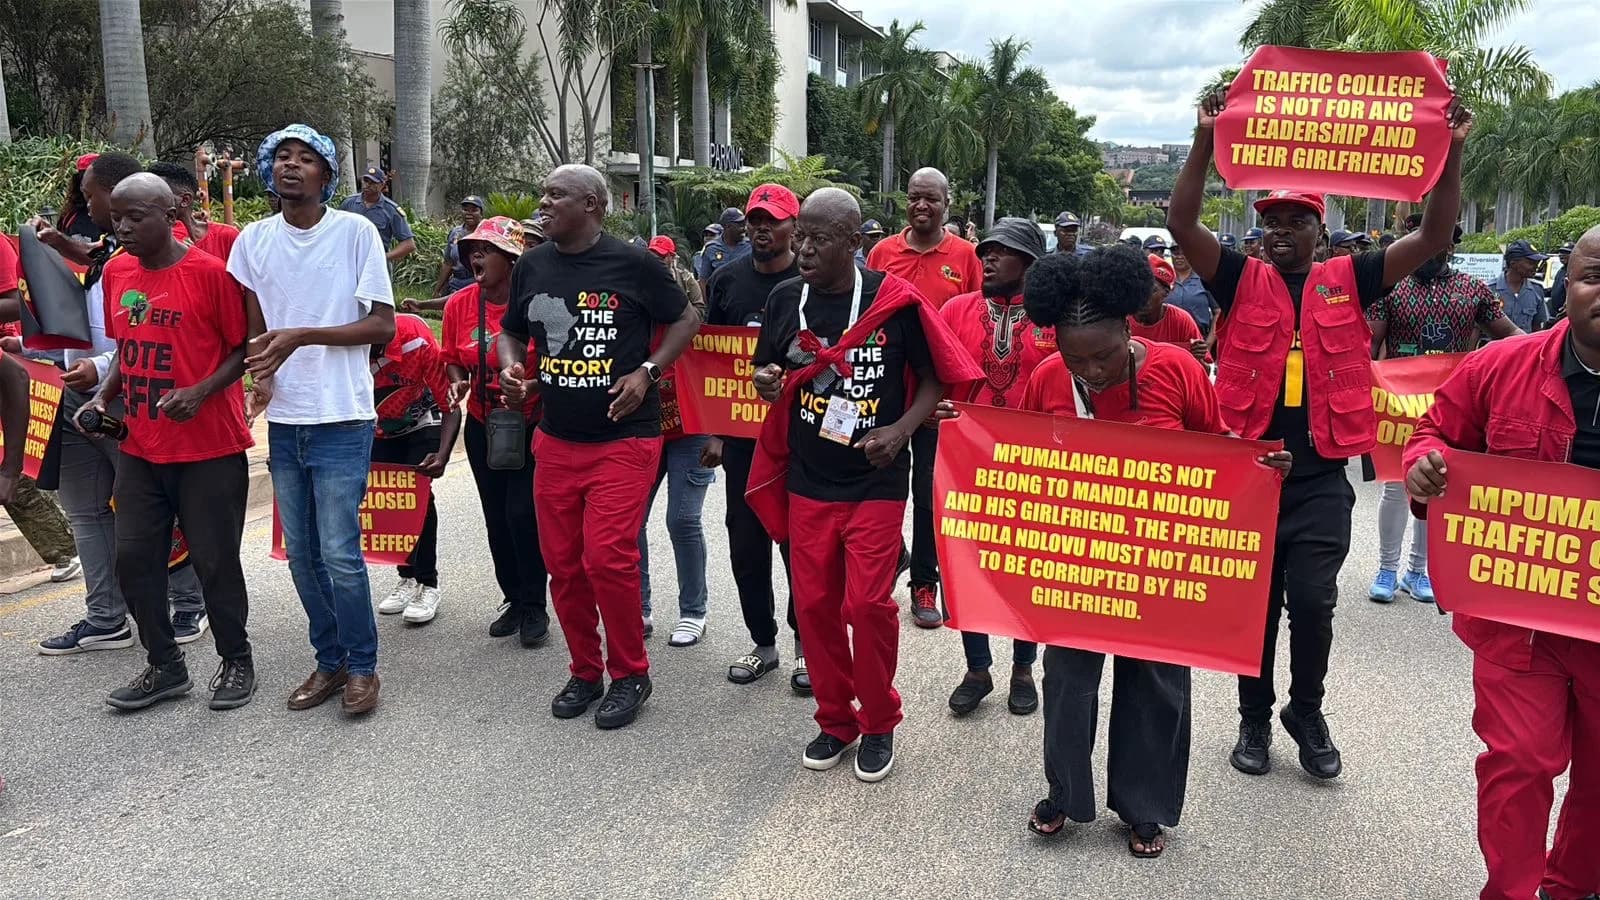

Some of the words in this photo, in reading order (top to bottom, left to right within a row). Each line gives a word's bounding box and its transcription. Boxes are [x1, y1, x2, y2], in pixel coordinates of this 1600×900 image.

[1252, 69, 1333, 94] TRAFFIC
[1336, 73, 1426, 98] COLLEGE
[1254, 96, 1277, 114] IS
[1280, 98, 1322, 117] NOT
[1325, 98, 1365, 120] FOR
[1368, 100, 1414, 122] ANC
[1246, 117, 1369, 146] LEADERSHIP
[1370, 126, 1416, 148] AND
[710, 142, 744, 171] PARKING
[1231, 144, 1287, 168] THEIR
[1292, 148, 1424, 178] GIRLFRIENDS
[576, 291, 619, 309] 2026
[152, 308, 182, 327] EFF
[581, 310, 614, 324] THE
[574, 326, 618, 341] YEAR
[692, 334, 743, 355] DOWN
[582, 344, 606, 358] OF
[539, 355, 614, 376] VICTORY
[853, 364, 885, 380] EAR
[540, 371, 553, 384] OR
[558, 375, 611, 388] DEATH!
[850, 384, 874, 398] OF
[800, 408, 815, 424] OR
[992, 443, 1119, 477] MPUMALANGA
[1122, 459, 1173, 484] DOES
[1176, 466, 1216, 489] NOT
[975, 468, 1042, 494] BELONG
[1046, 476, 1068, 498] TO
[1072, 482, 1149, 510] MANDLA
[1152, 492, 1230, 520] NDLOVU
[944, 490, 982, 514] AND
[985, 496, 1017, 518] HIS
[1020, 500, 1130, 536] GIRLFRIEND.
[1134, 516, 1170, 540] THE
[1173, 522, 1262, 552] PREMIER
[940, 516, 1011, 545] MANDLA
[1014, 528, 1086, 557] NDLOVU
[1089, 539, 1144, 565] MUST
[1147, 548, 1187, 571] NOT
[1188, 556, 1258, 580] ALLOW
[1443, 512, 1581, 564] TRAFFIC
[978, 549, 1001, 570] TO
[1004, 554, 1027, 576] BE
[1030, 558, 1140, 593] CORRUPTED
[1143, 576, 1169, 597] BY
[1173, 580, 1208, 602] HIS
[1468, 553, 1580, 600] CRIME
[1031, 585, 1142, 620] GIRLFRIEND.
